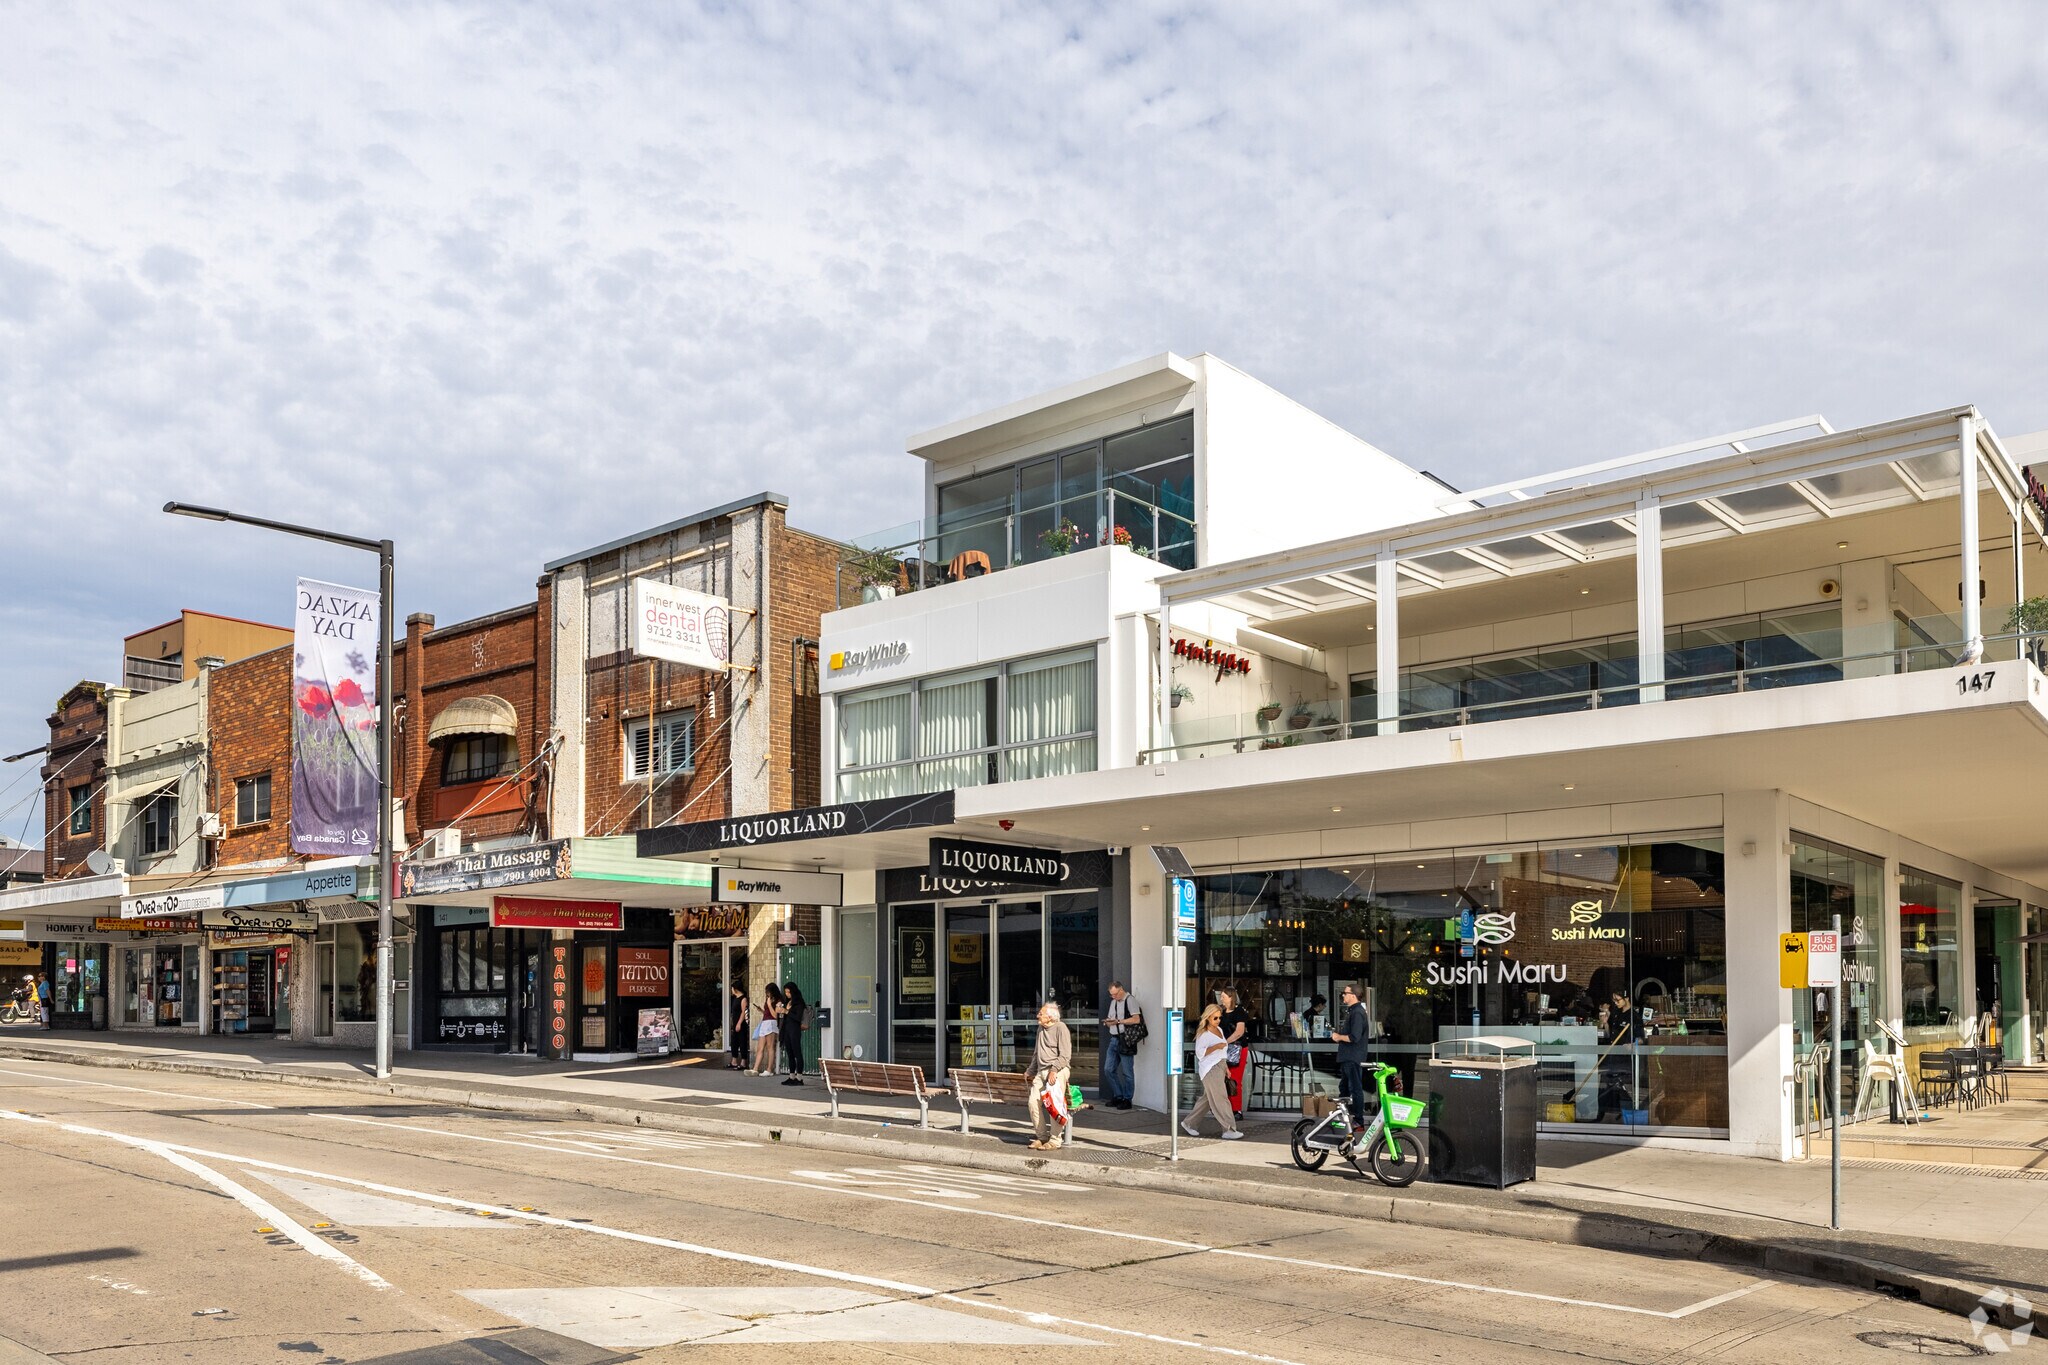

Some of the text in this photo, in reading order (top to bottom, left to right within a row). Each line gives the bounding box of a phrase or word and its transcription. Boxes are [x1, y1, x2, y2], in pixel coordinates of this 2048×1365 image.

[645, 592, 701, 615] inner west
[646, 605, 701, 632] dental
[646, 624, 702, 645] 9712 3311
[1957, 671, 1996, 694] 147
[720, 811, 846, 844] LIQUORLAND
[456, 854, 487, 872] Thai
[490, 849, 551, 868] Massage
[942, 849, 1058, 875] LIQUORLAND
[306, 873, 351, 893] Appetite
[504, 871, 525, 881] 7901
[528, 867, 551, 878] 4004
[146, 920, 166, 928] HOT
[231, 916, 261, 928] OVER
[271, 918, 292, 928] TOP
[552, 907, 574, 917] Thai
[576, 909, 614, 921] Massage
[699, 908, 728, 931] Thai
[46, 924, 84, 932] HOMIFY
[1551, 927, 1625, 940] Sushi Maru
[954, 944, 976, 952] MATCH
[619, 965, 668, 980] TATTOO
[1426, 960, 1567, 985] Sushi Maru
[1842, 959, 1875, 983] Sushi Maru
[552, 946, 566, 1049] TATTOO
[629, 985, 658, 993] PURPOSE
